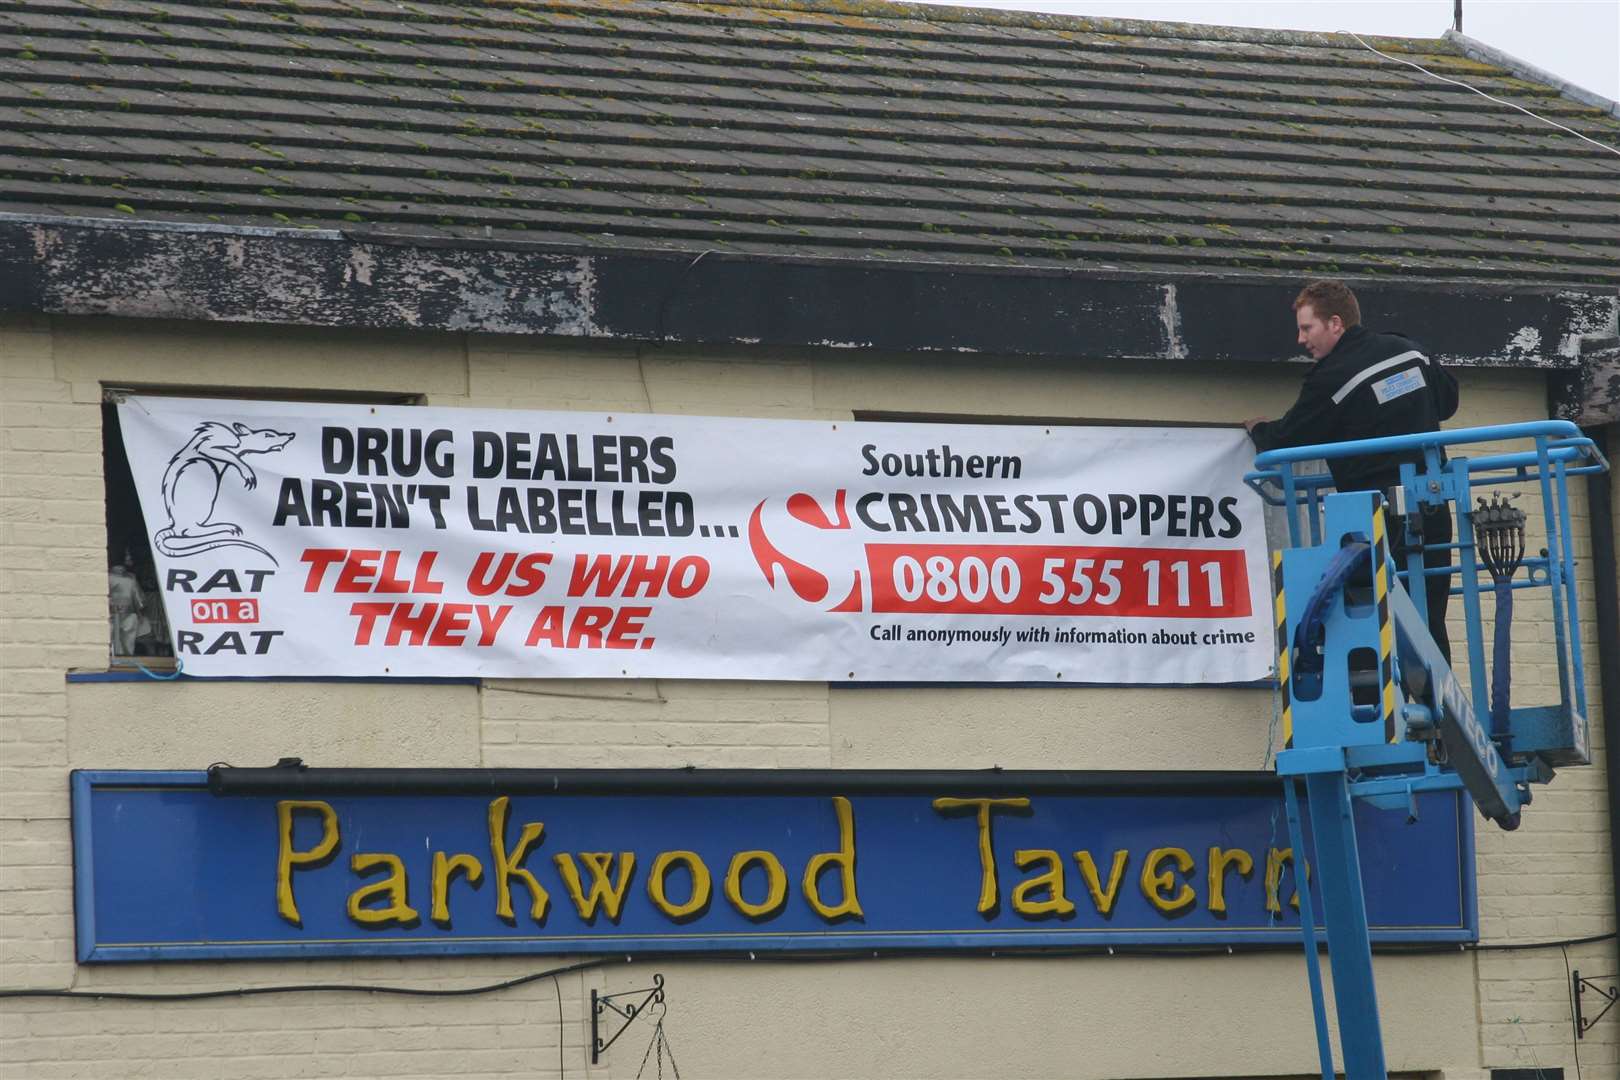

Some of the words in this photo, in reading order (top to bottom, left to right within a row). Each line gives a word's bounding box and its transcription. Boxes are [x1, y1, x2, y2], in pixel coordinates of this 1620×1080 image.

[322, 426, 455, 479] DRUG
[472, 430, 677, 485] DEALERS
[861, 444, 1022, 479] Southern
[272, 477, 450, 529] AREN'T
[467, 485, 740, 538] LABELLED...
[855, 491, 1242, 539] CRIMESTOPPERS
[166, 568, 275, 593] RAT
[300, 548, 444, 595] TELL
[466, 551, 553, 597] US
[567, 553, 711, 599] WHO
[893, 555, 1022, 604] 0800
[1038, 556, 1124, 606] 555
[1142, 559, 1224, 608] 111
[193, 601, 229, 621] on
[238, 601, 257, 621] a
[350, 602, 512, 647] THEY
[525, 605, 656, 650] ARE.
[177, 630, 284, 656] RAT
[870, 624, 902, 642] Call
[906, 625, 1012, 647] anonymously
[1016, 626, 1050, 644] with
[1054, 626, 1148, 645] information
[1151, 627, 1198, 646] about
[1202, 628, 1255, 645] crime
[276, 796, 864, 923] Parkwood
[932, 796, 1312, 914] Tavern
